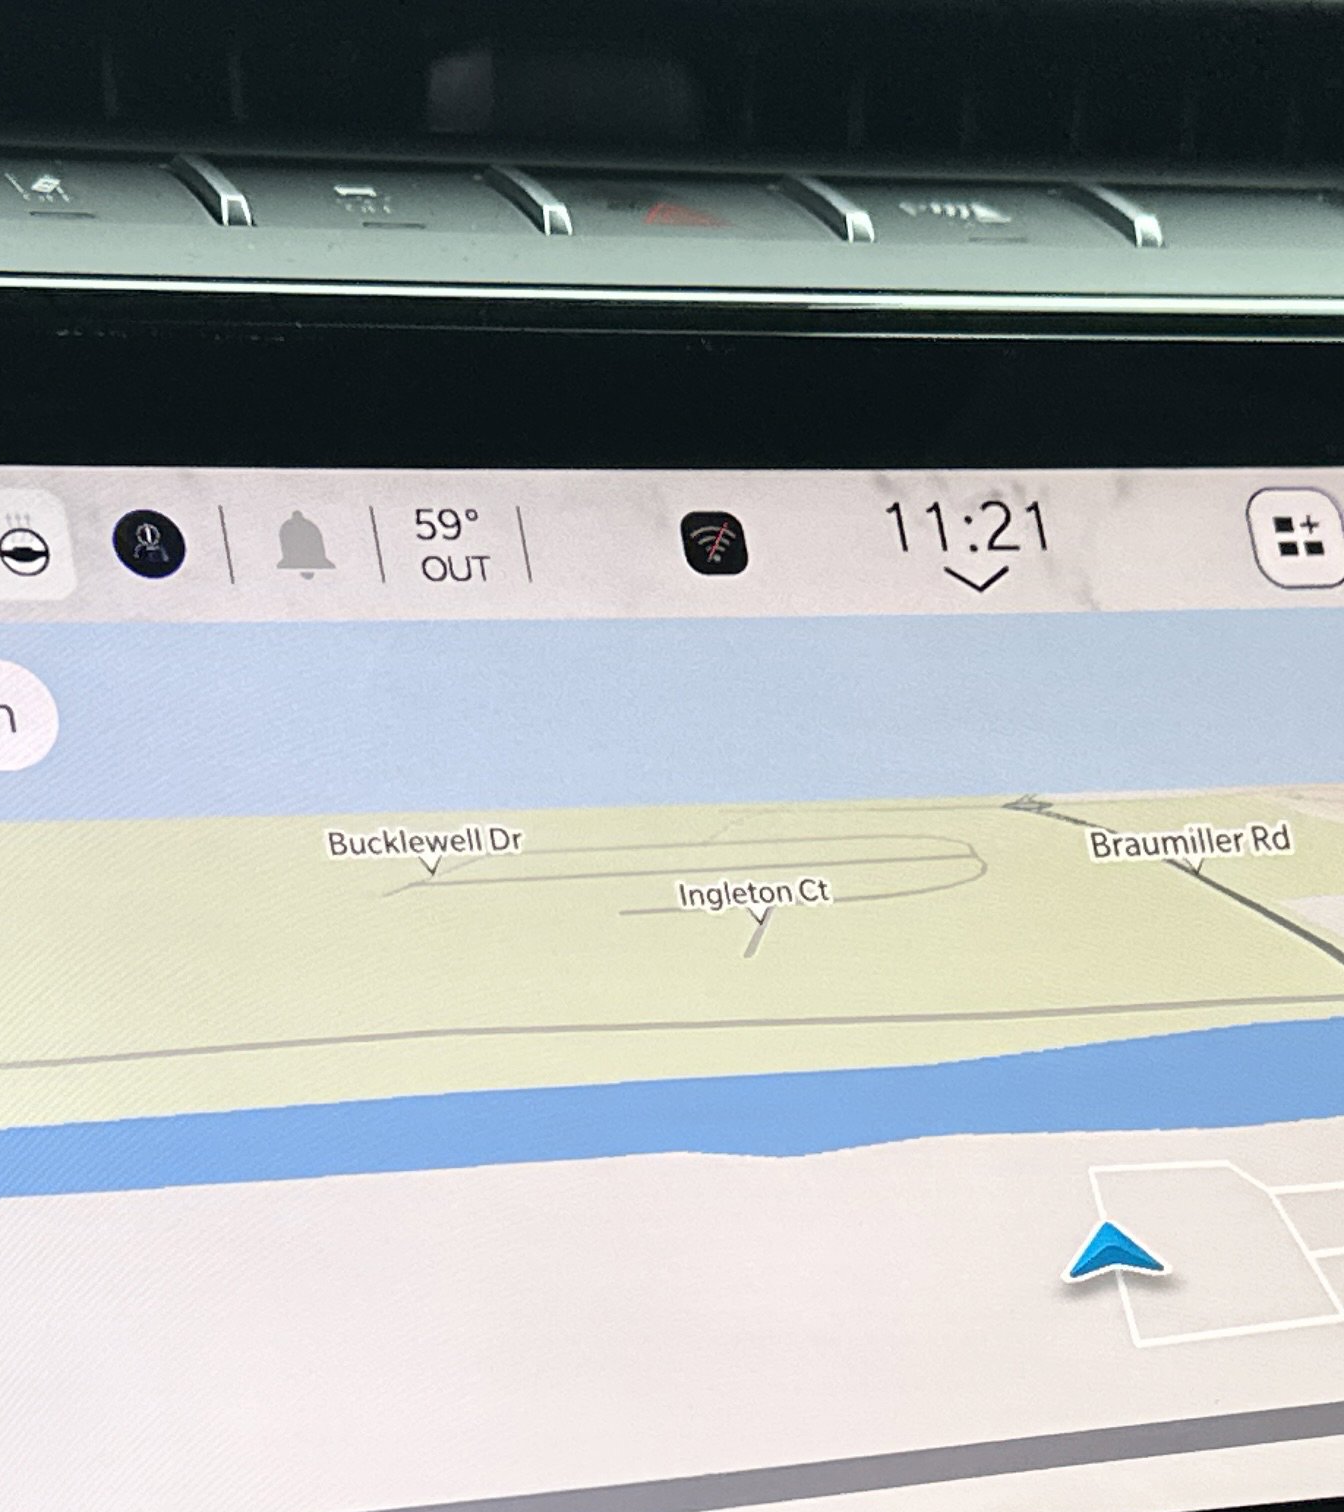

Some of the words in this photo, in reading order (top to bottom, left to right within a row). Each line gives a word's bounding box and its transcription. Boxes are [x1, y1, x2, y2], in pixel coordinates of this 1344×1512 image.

[414, 507, 480, 542] 59°
[885, 499, 1049, 554] 11:21
[420, 554, 492, 583] OUT
[327, 826, 483, 857] Bucklewell
[488, 826, 522, 852] Dr
[1089, 826, 1244, 859] Braumiller
[1250, 822, 1292, 852] Rd
[678, 881, 793, 911] Ingleton
[797, 877, 830, 902] Ct
